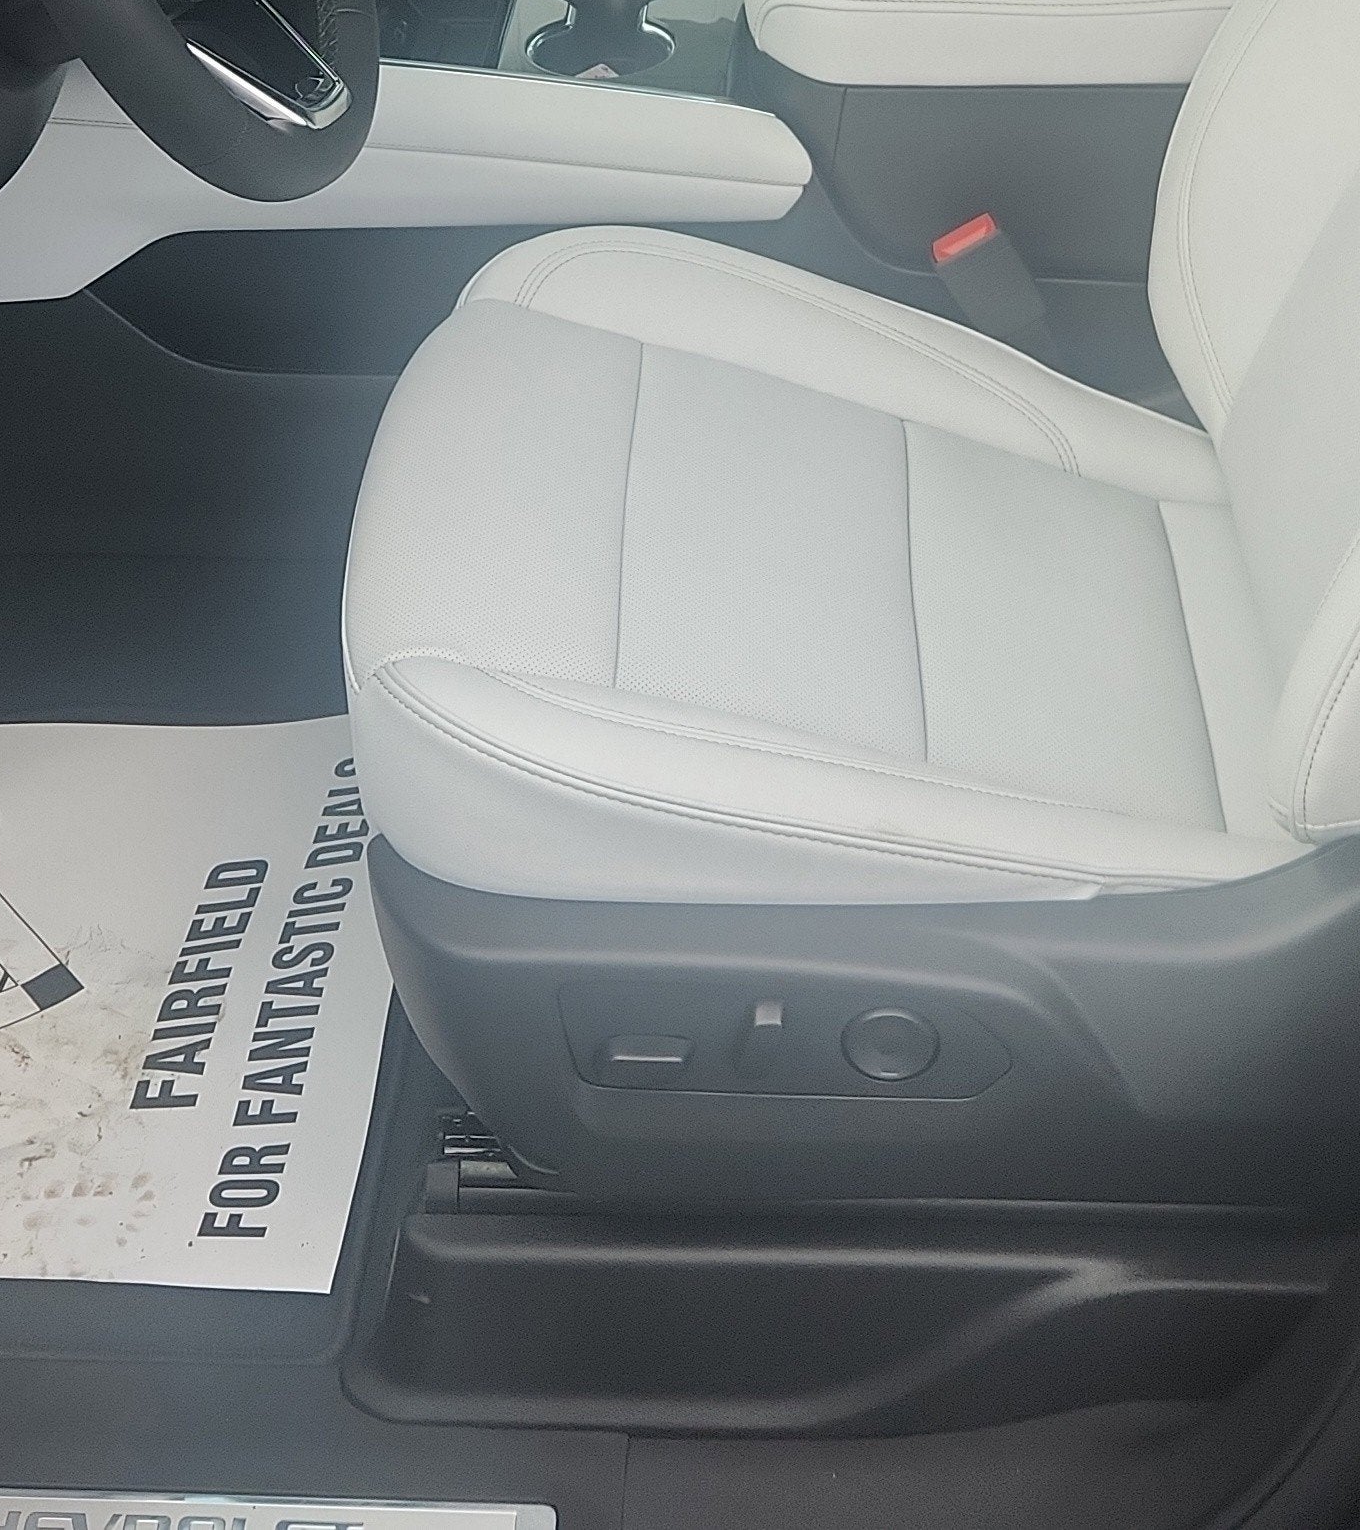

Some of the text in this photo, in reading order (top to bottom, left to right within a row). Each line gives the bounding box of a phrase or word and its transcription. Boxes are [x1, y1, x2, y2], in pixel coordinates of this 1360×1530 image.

[129, 858, 269, 1110] FAIRFIELD
[232, 877, 354, 1127] FANTASTIC
[196, 1142, 292, 1238] FOR
